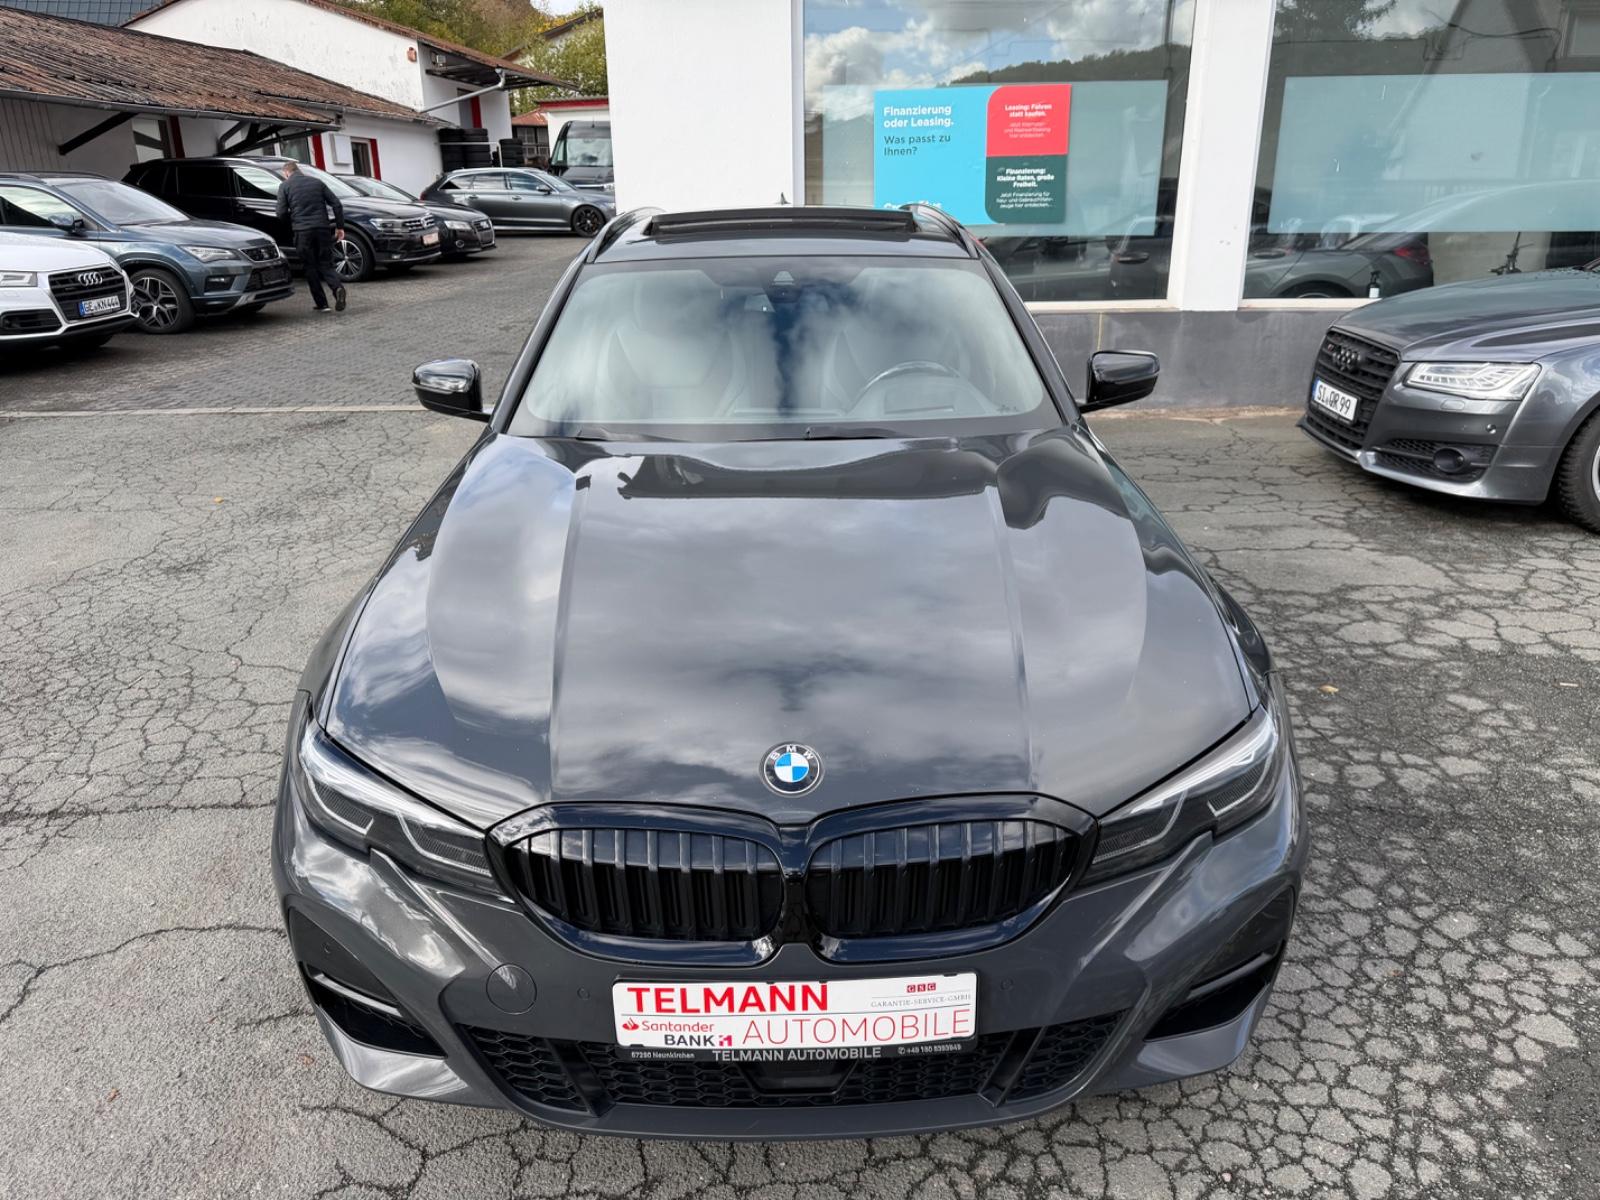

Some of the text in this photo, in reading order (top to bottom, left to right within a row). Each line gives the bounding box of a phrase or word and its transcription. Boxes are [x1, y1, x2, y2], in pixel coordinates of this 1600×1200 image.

[883, 105, 952, 116] Finanzierung
[883, 116, 954, 128] oder Leasing.
[884, 134, 951, 145] Was passt zu
[884, 146, 918, 156] Ihnen?
[626, 984, 829, 1014] TELMANN
[641, 1020, 715, 1033] Santander
[742, 1008, 971, 1045] AUTOMOBILE
[664, 1034, 715, 1048] BANK
[711, 1046, 882, 1062] TELMANN AUTOMOBILE
